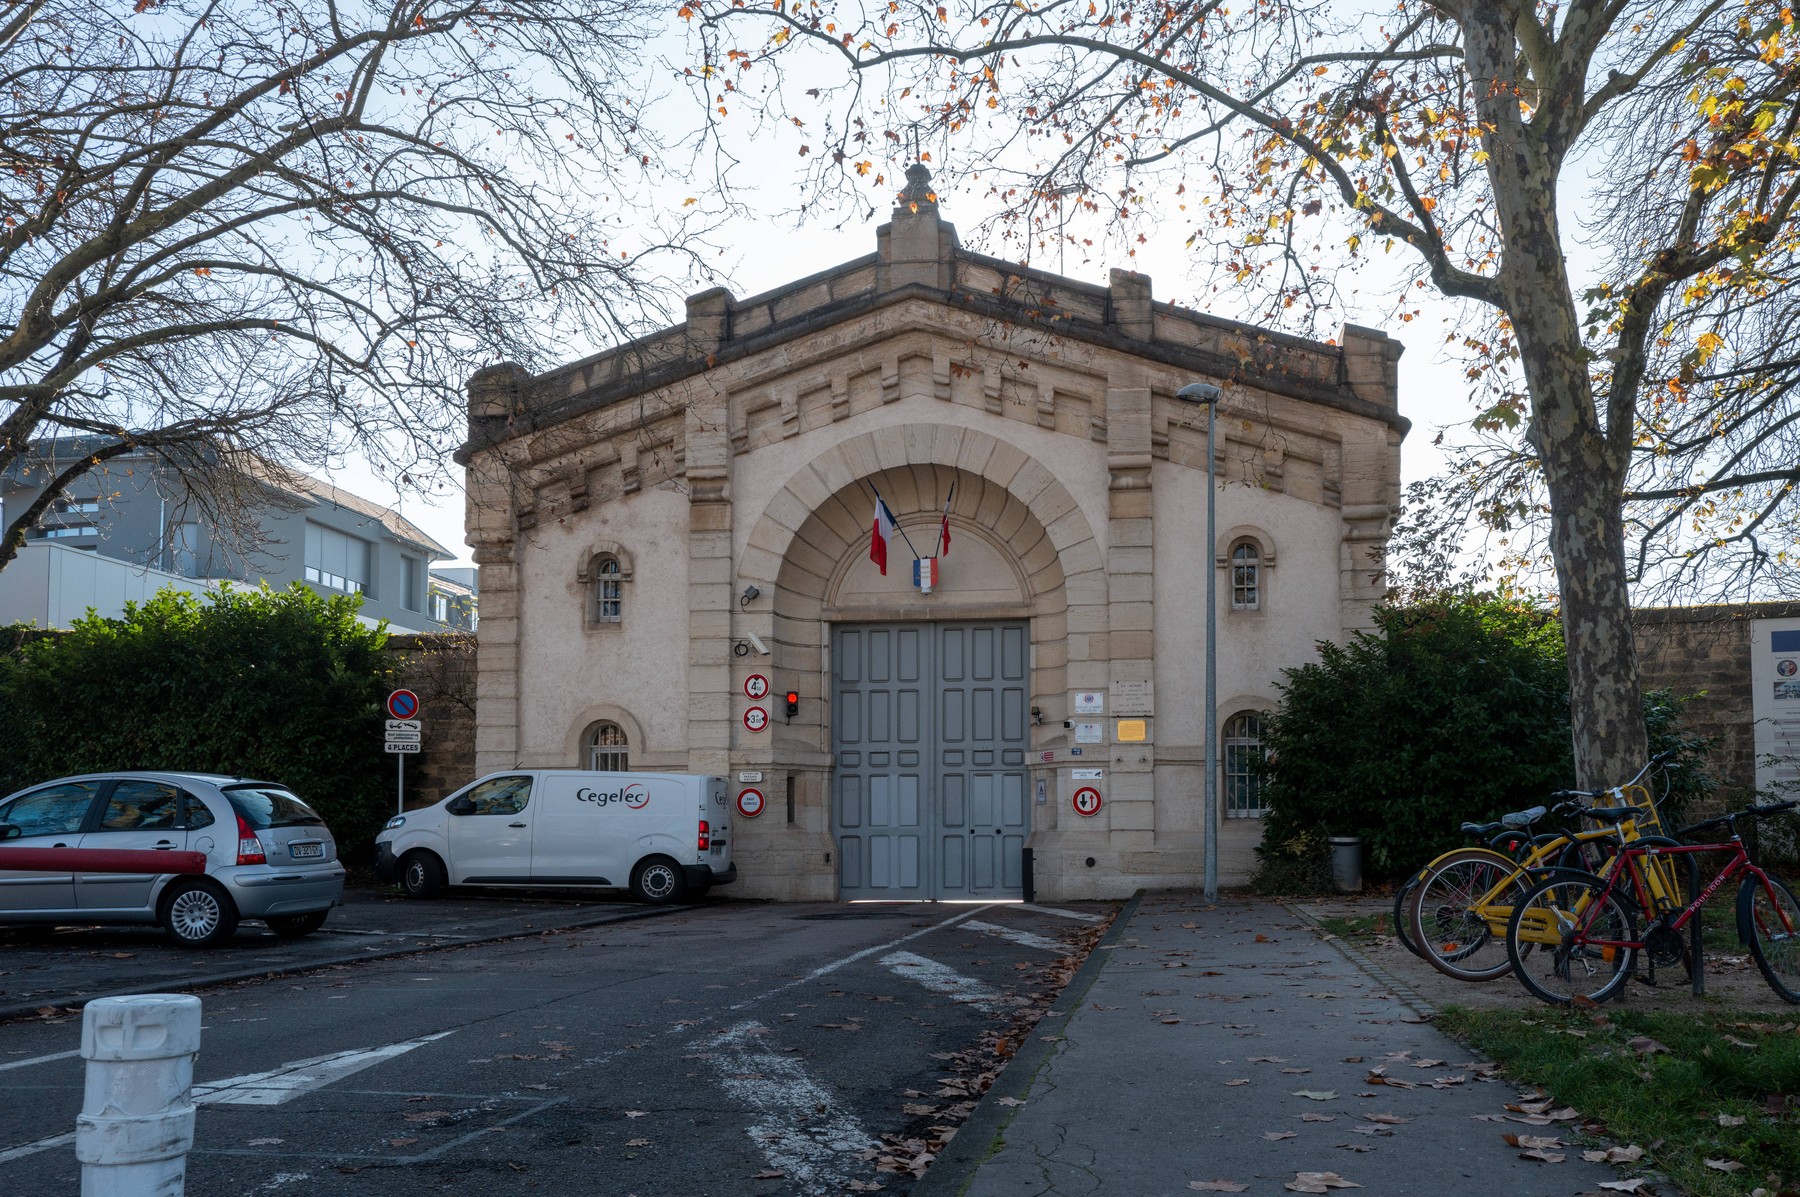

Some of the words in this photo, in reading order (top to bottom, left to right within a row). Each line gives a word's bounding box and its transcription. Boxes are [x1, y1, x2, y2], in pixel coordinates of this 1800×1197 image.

[751, 681, 757, 691] 4
[750, 714, 756, 724] 3
[576, 787, 644, 807] Cegelec
